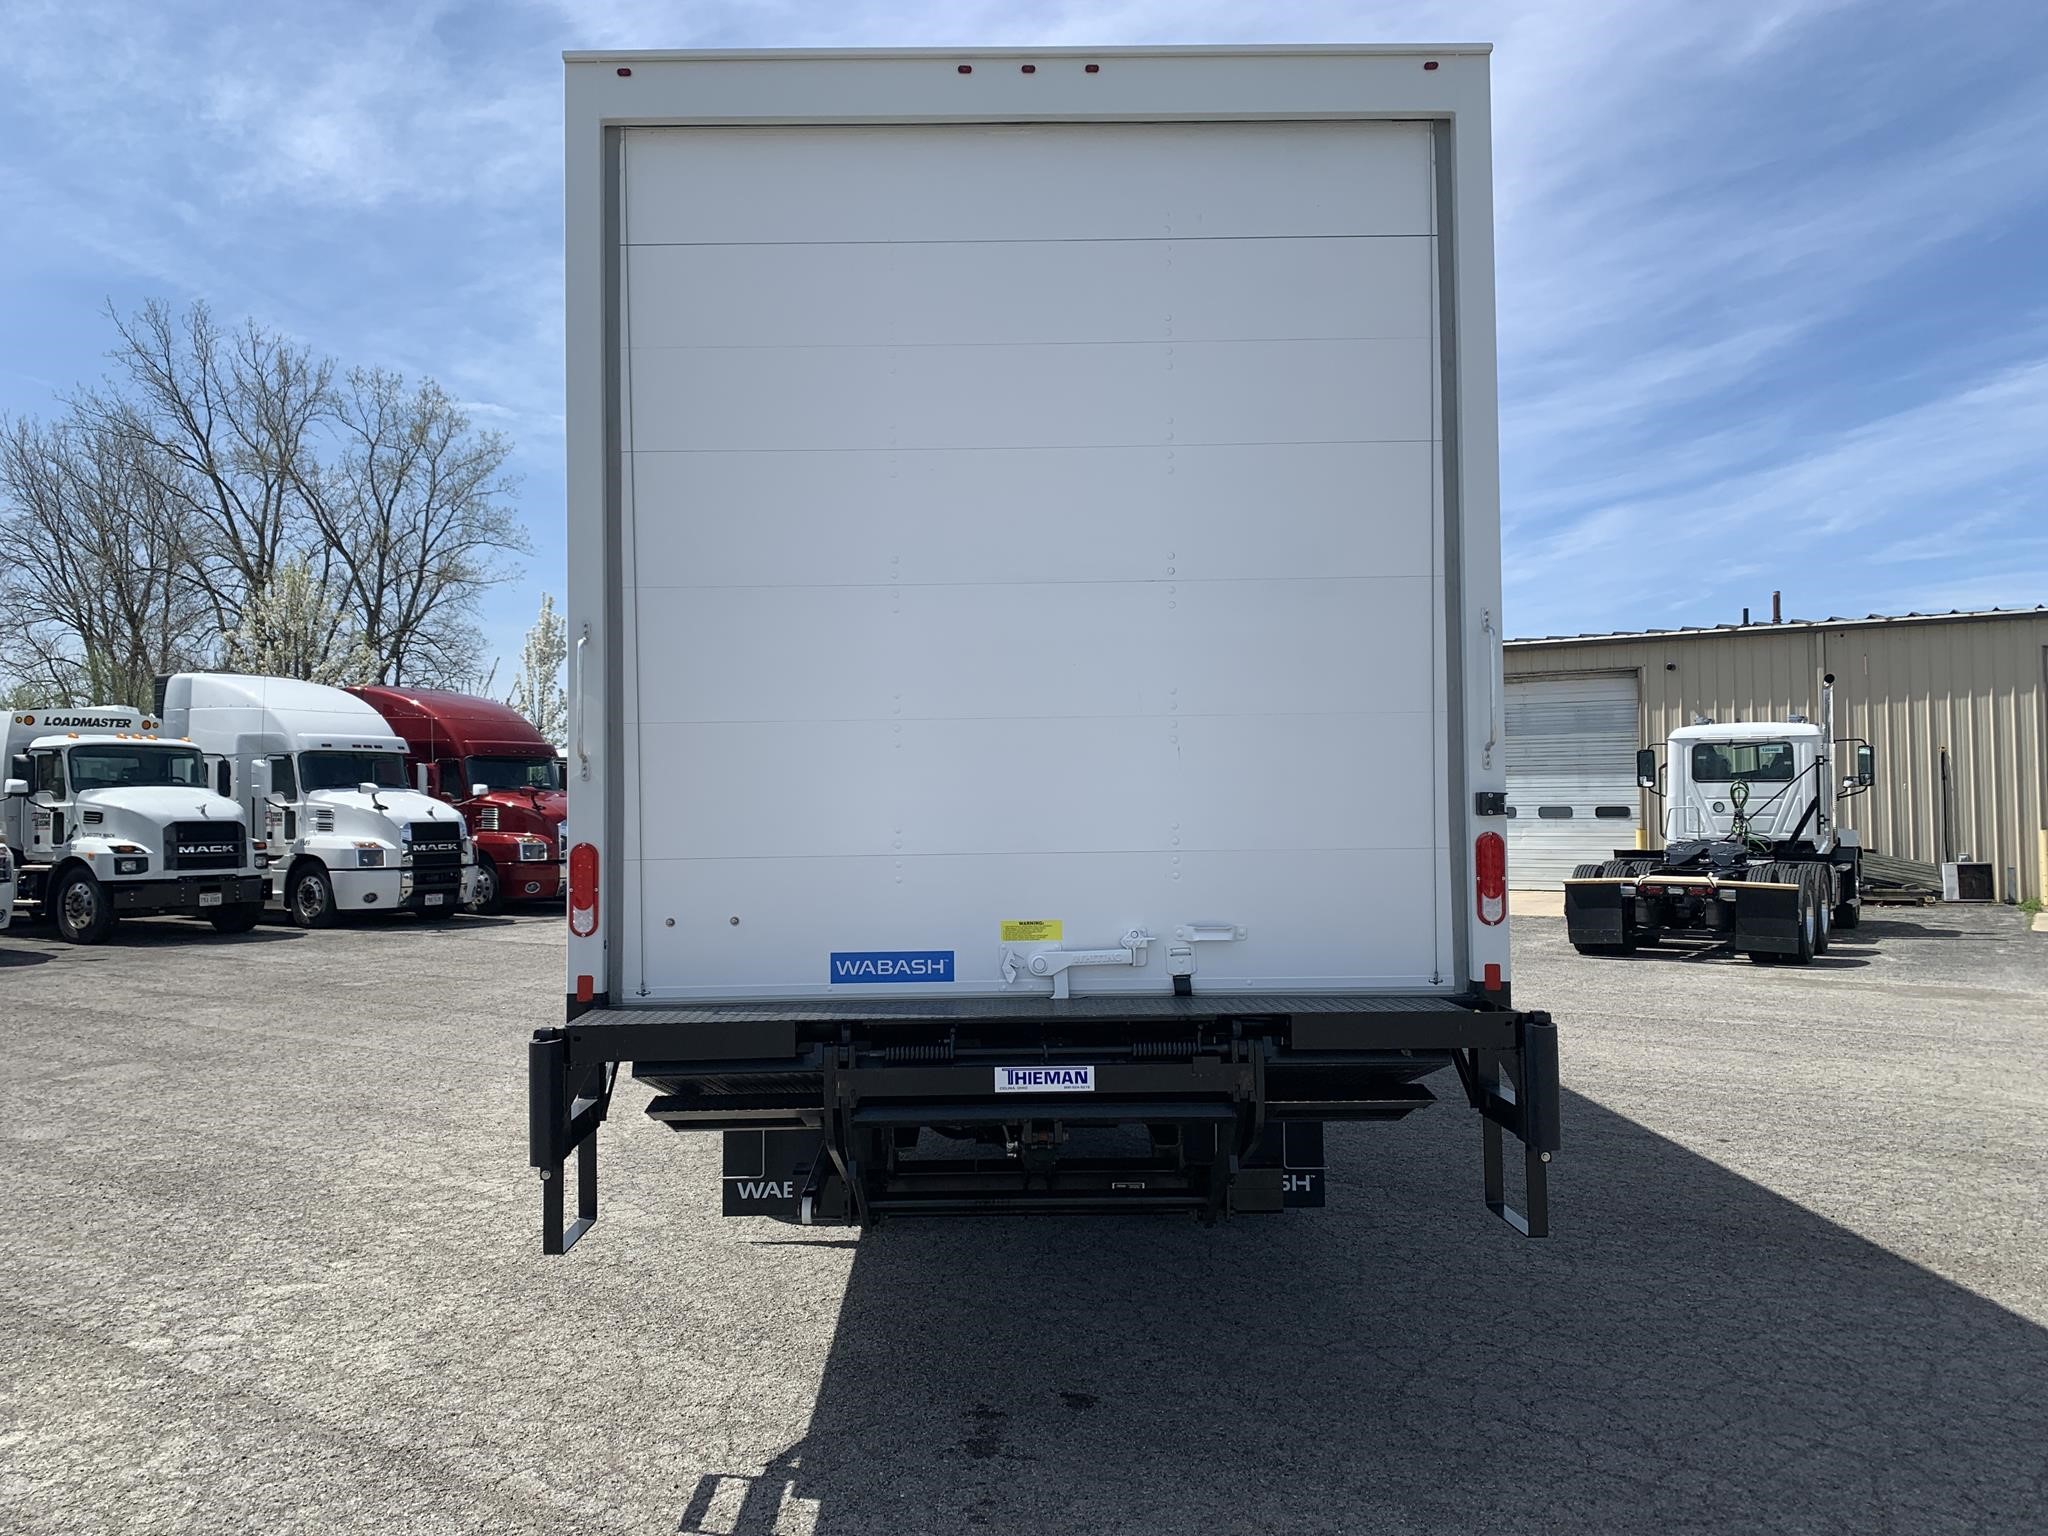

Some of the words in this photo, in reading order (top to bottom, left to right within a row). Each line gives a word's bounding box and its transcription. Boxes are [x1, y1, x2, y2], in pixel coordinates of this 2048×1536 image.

[43, 716, 132, 728] LOADMASTER
[178, 845, 235, 854] MACK
[412, 843, 458, 852] MACK
[836, 959, 945, 976] WABASH
[1001, 1067, 1088, 1086] THIEMAN
